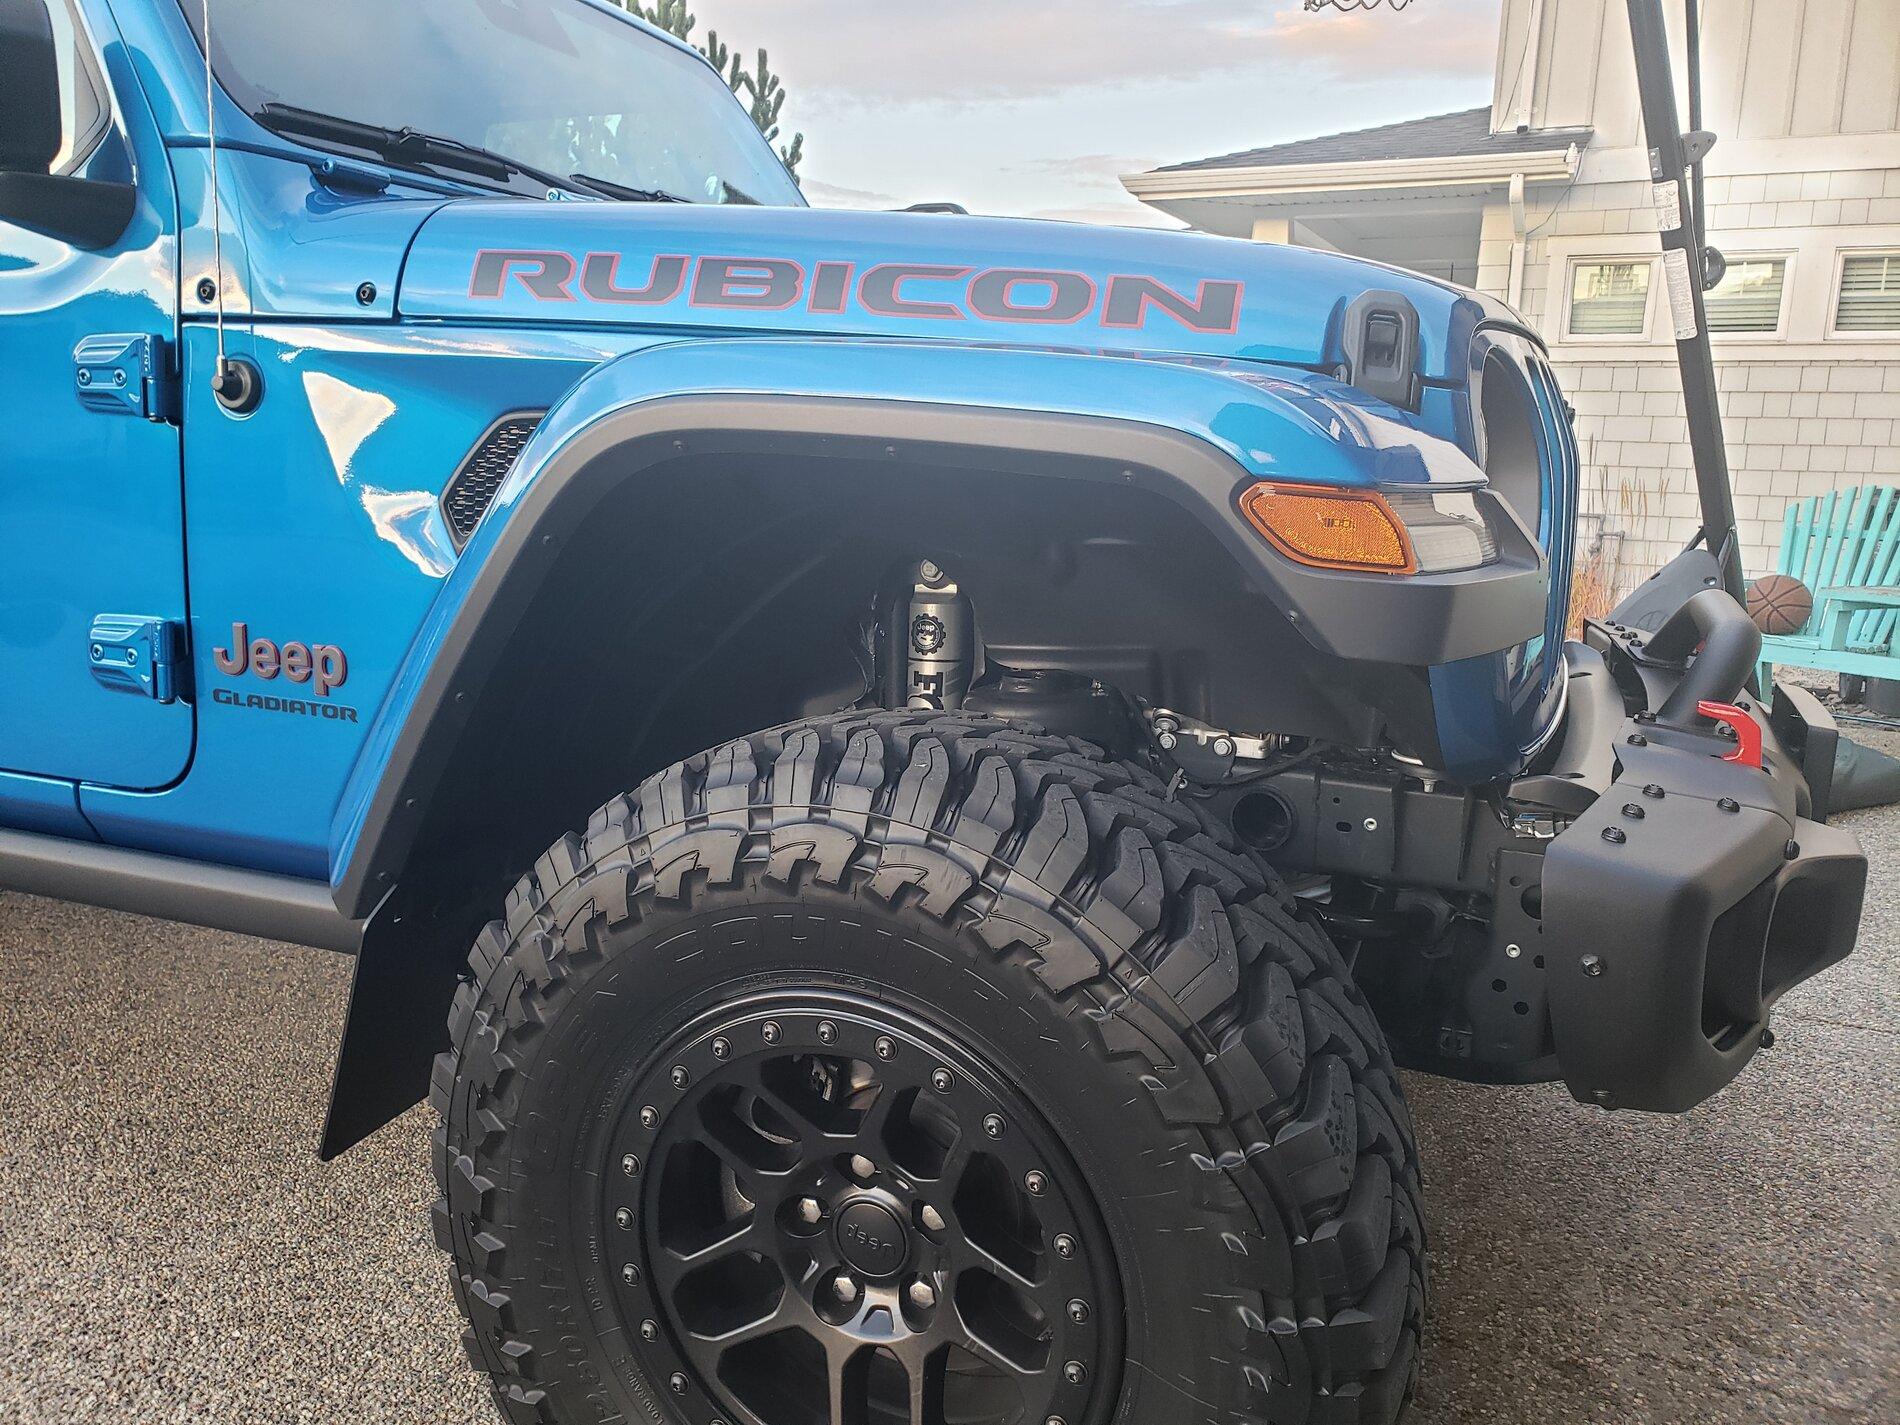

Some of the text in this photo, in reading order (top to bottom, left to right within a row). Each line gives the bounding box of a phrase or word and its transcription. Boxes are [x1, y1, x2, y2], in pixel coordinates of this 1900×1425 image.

[469, 249, 1244, 335] RUBICON
[917, 623, 935, 632] Jeep
[213, 622, 348, 696] Jeep
[213, 688, 358, 723] GLADIATOR
